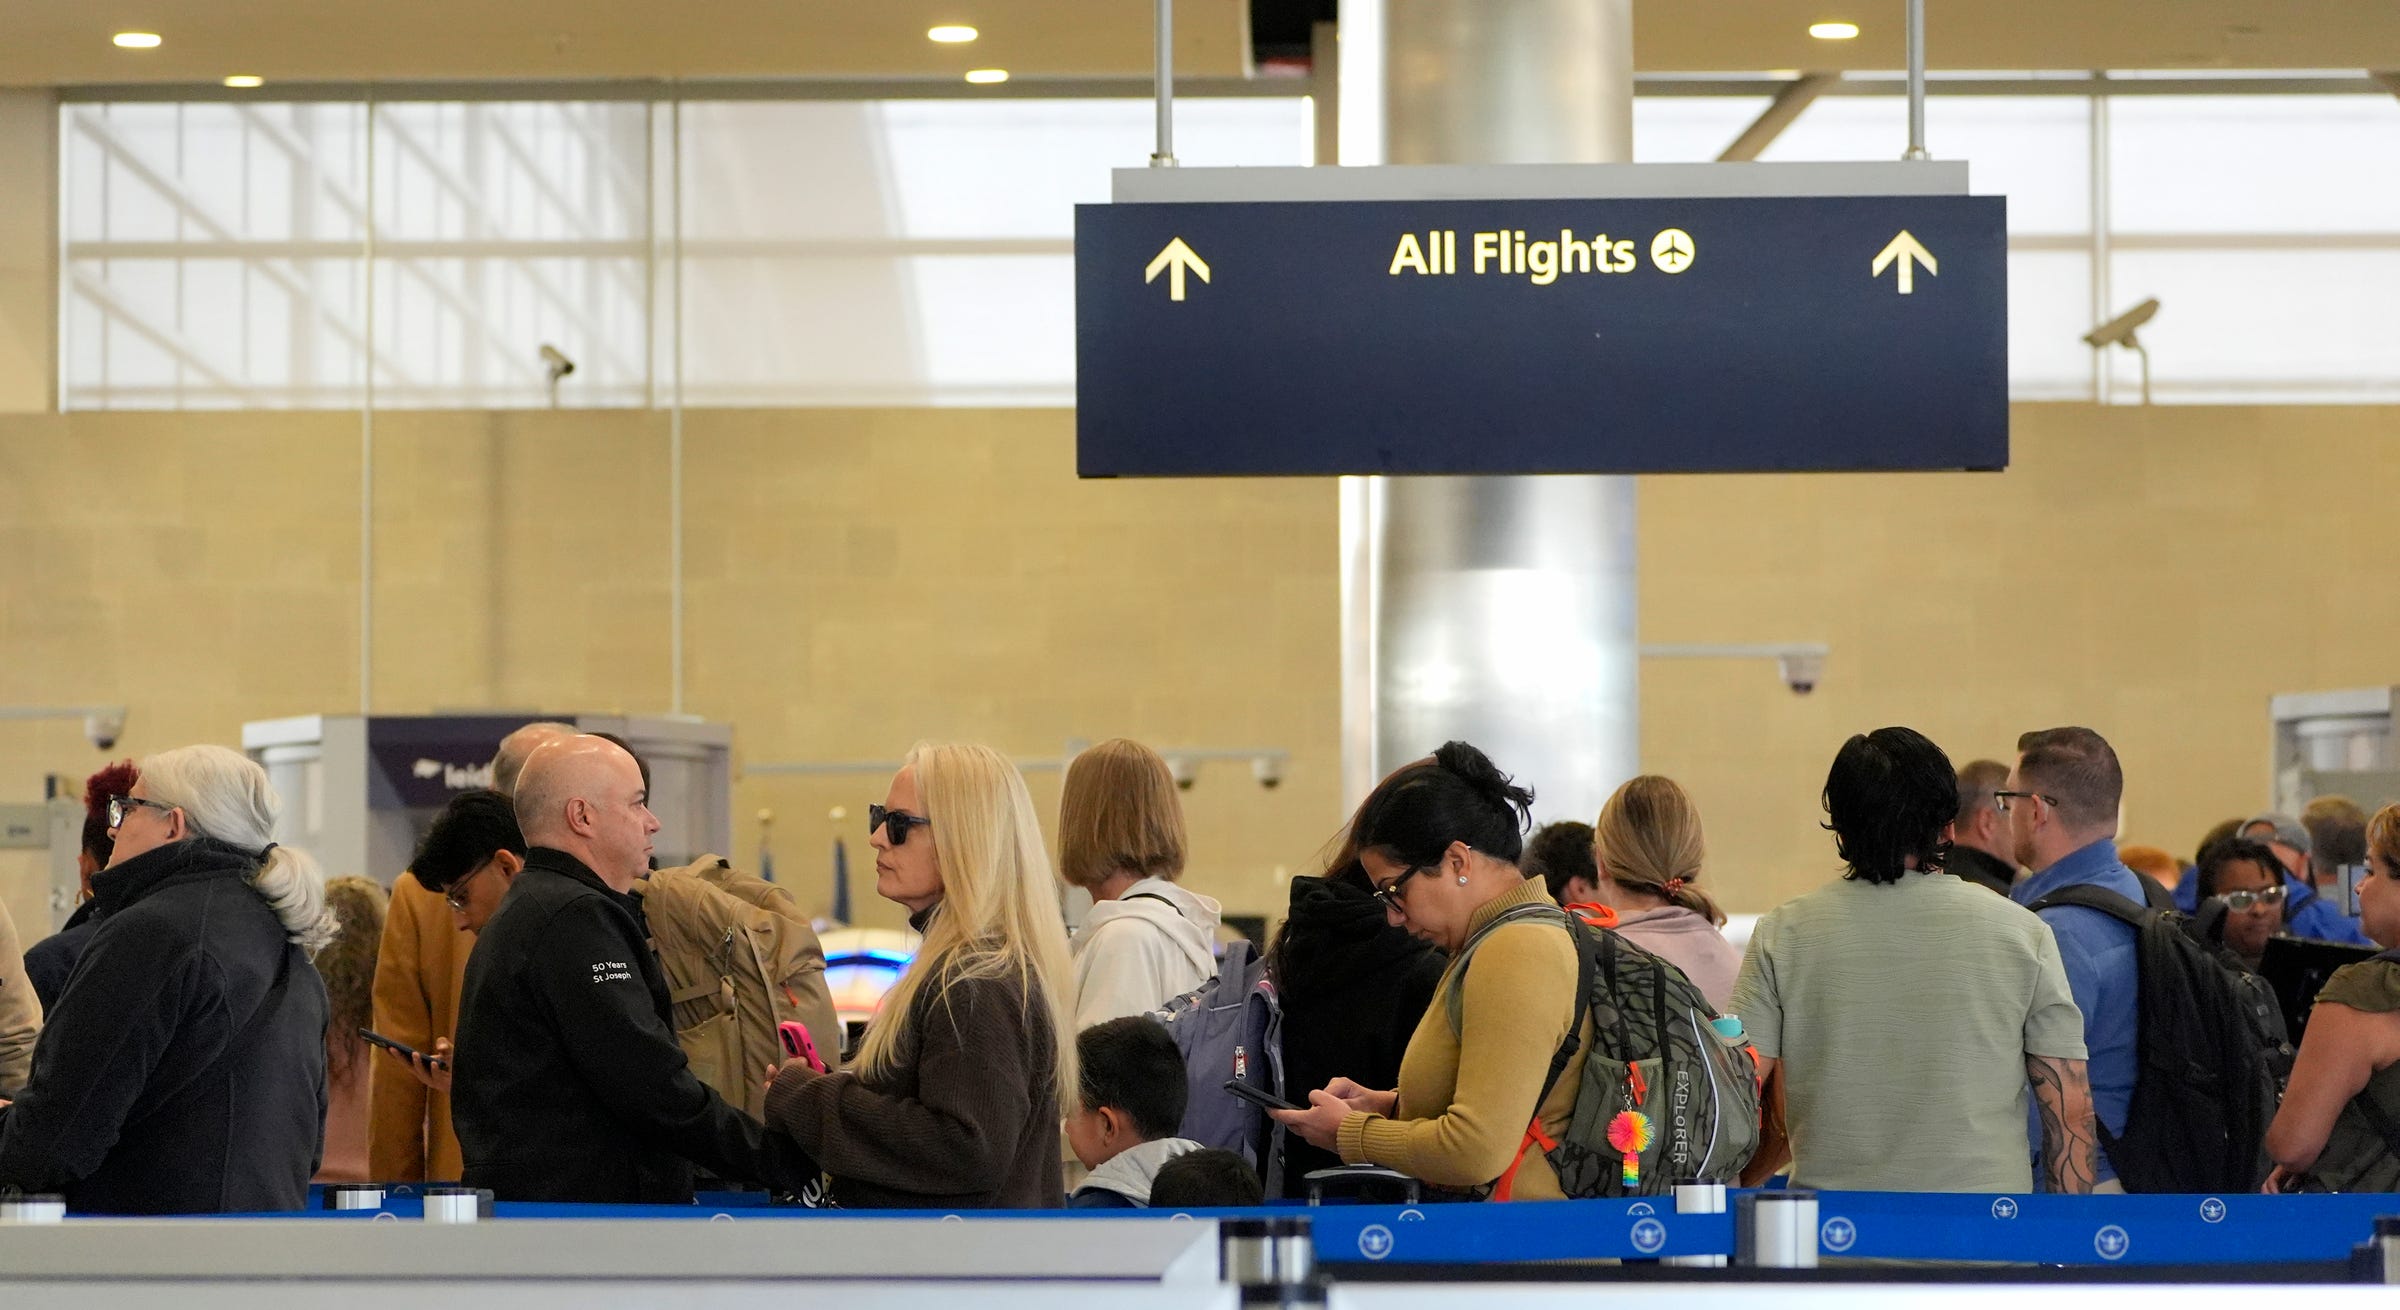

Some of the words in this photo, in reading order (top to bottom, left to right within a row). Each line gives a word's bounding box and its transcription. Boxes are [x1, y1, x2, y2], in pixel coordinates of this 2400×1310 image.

[1389, 230, 1456, 275] All
[1473, 229, 1637, 285] Flights
[592, 963, 605, 973] 50
[605, 961, 628, 969] Years
[593, 974, 604, 983] St
[605, 971, 632, 981] Joseph
[1673, 1070, 1689, 1164] EXPLORER
